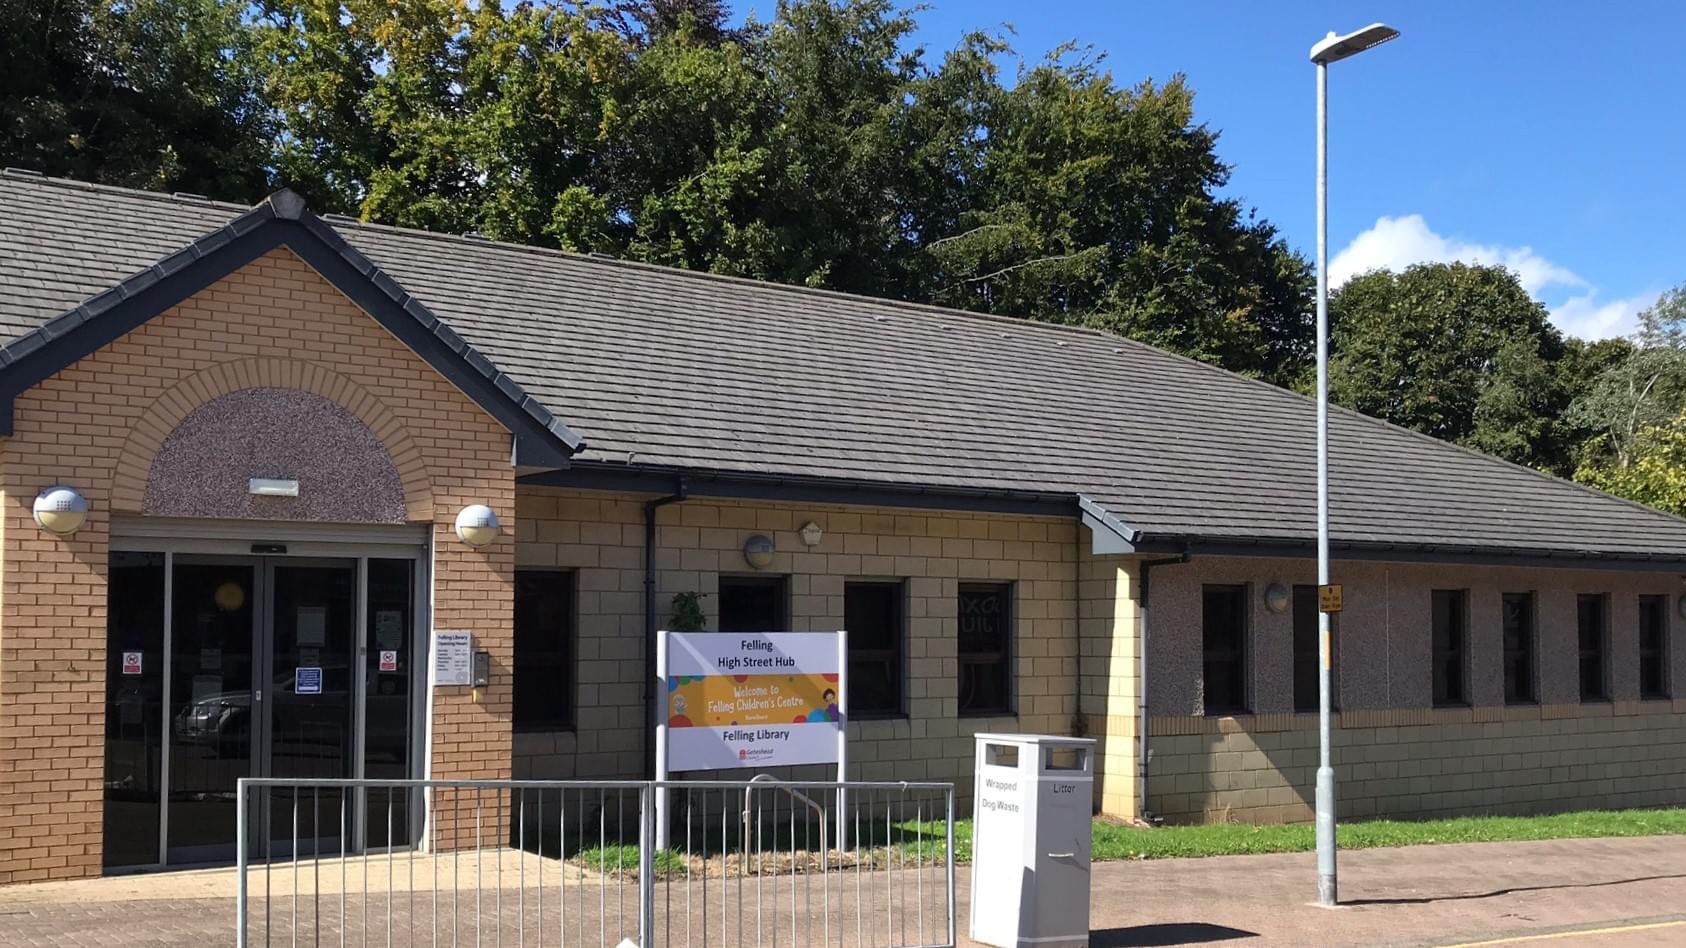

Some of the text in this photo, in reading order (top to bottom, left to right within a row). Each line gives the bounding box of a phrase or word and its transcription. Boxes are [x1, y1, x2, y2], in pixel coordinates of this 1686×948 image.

[741, 640, 773, 652] Felling
[718, 656, 795, 669] High Street Hub
[734, 685, 779, 697] Welcome to
[708, 696, 804, 713] Felling Children's Centre
[723, 728, 790, 742] Felling Library
[985, 778, 1018, 792] Wrapped
[1053, 783, 1076, 793] Litter
[982, 798, 1020, 813] Dog Waste
